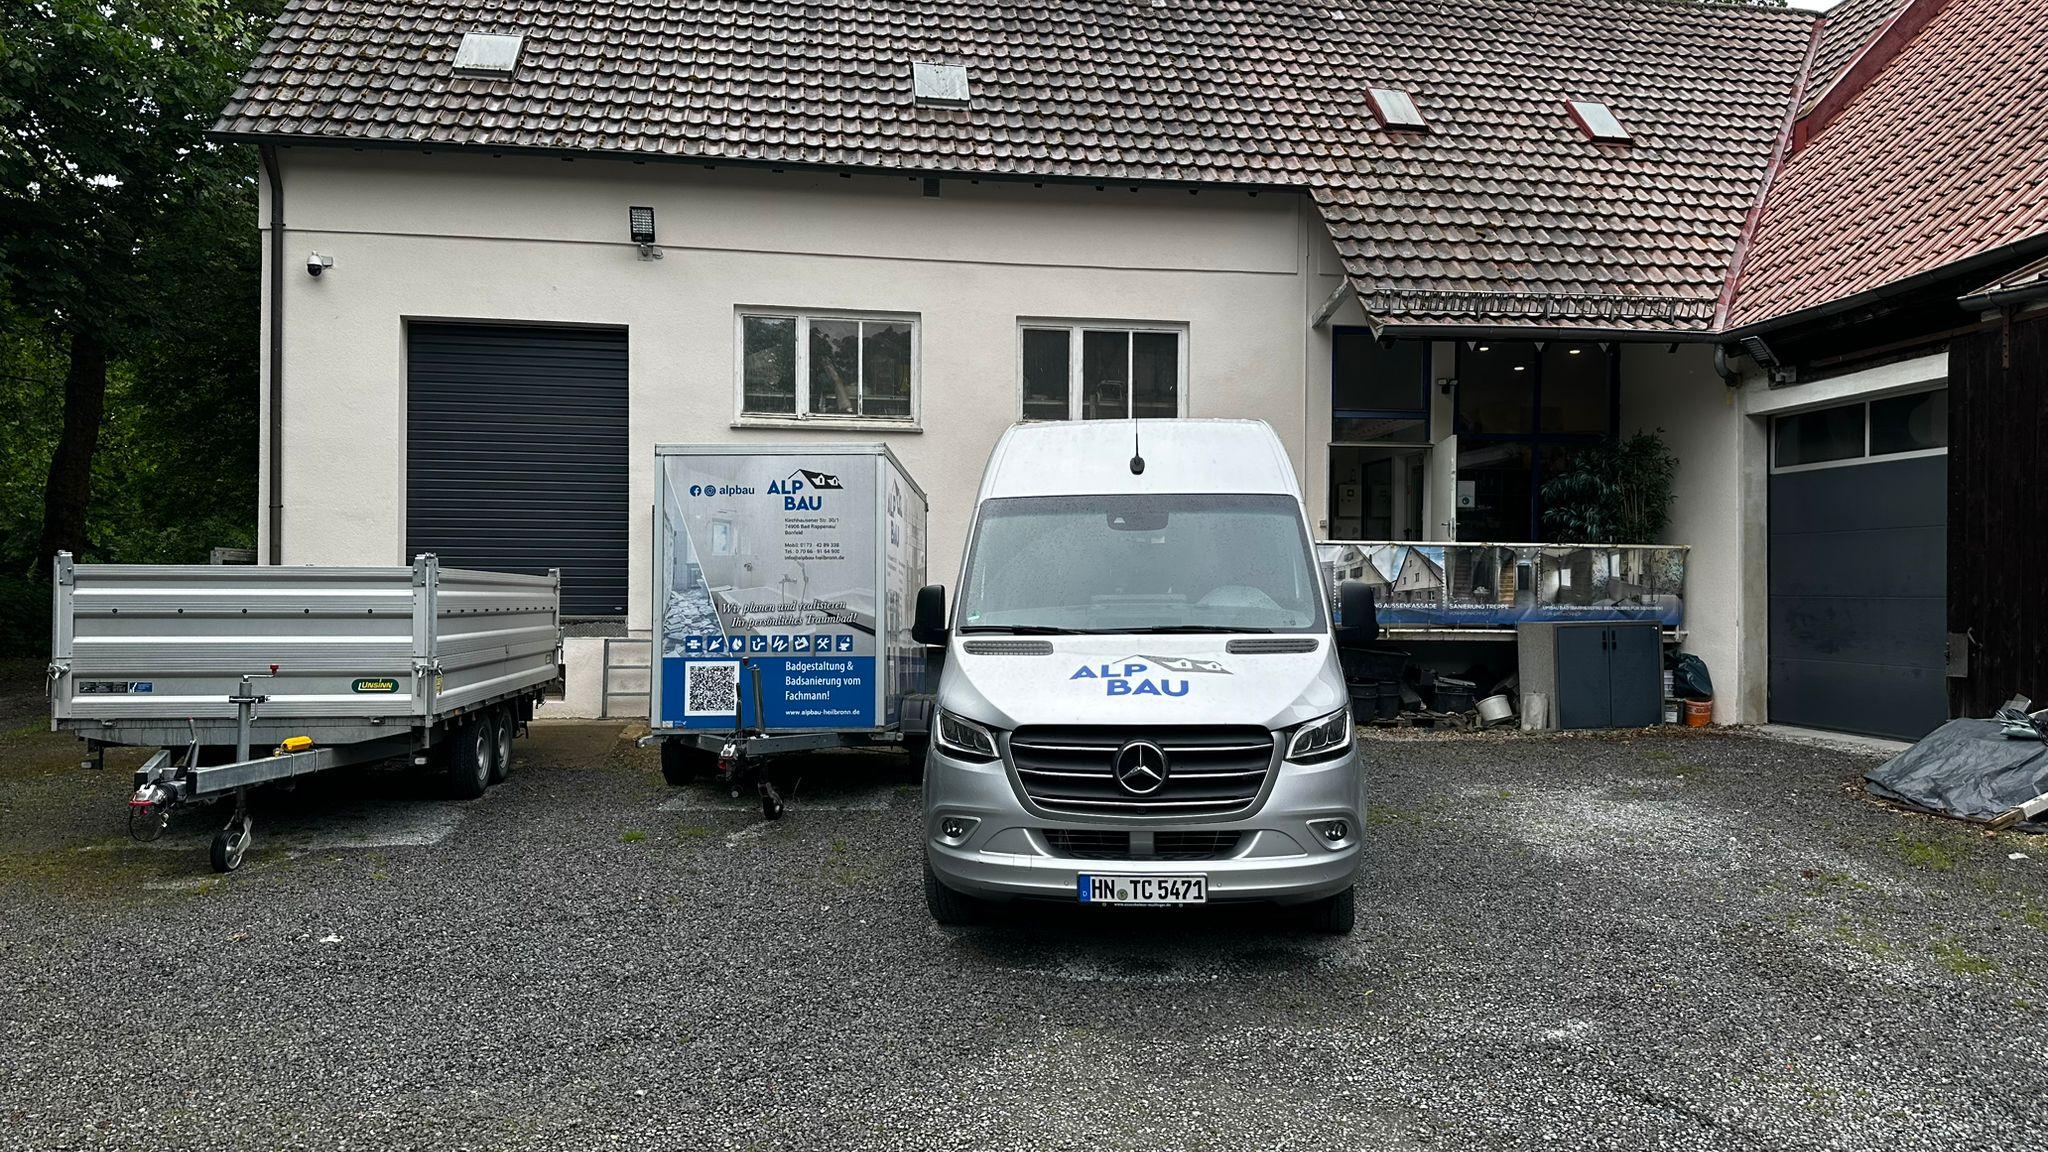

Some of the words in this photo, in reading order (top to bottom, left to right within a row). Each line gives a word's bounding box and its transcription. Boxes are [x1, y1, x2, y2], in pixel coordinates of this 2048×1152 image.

[719, 485, 755, 497] alpbau
[767, 479, 804, 494] ALP
[785, 496, 822, 511] BAU
[722, 602, 741, 614] Wir
[742, 601, 776, 615] planen
[777, 601, 796, 612] und
[799, 599, 846, 612] realisieren
[731, 616, 746, 628] Ihr
[746, 615, 802, 630] persönliches
[806, 613, 858, 625] Traumbad!
[785, 661, 845, 673] Badgestaltung
[847, 661, 854, 670] &
[1069, 663, 1147, 680] ALP
[785, 676, 841, 687] Badsanierung
[843, 677, 861, 685] vom
[1107, 678, 1189, 697] BAU
[785, 691, 830, 700] Fachmann!
[1092, 879, 1115, 899] HN
[1130, 880, 1153, 900] TC
[1158, 880, 1204, 900] 5471
